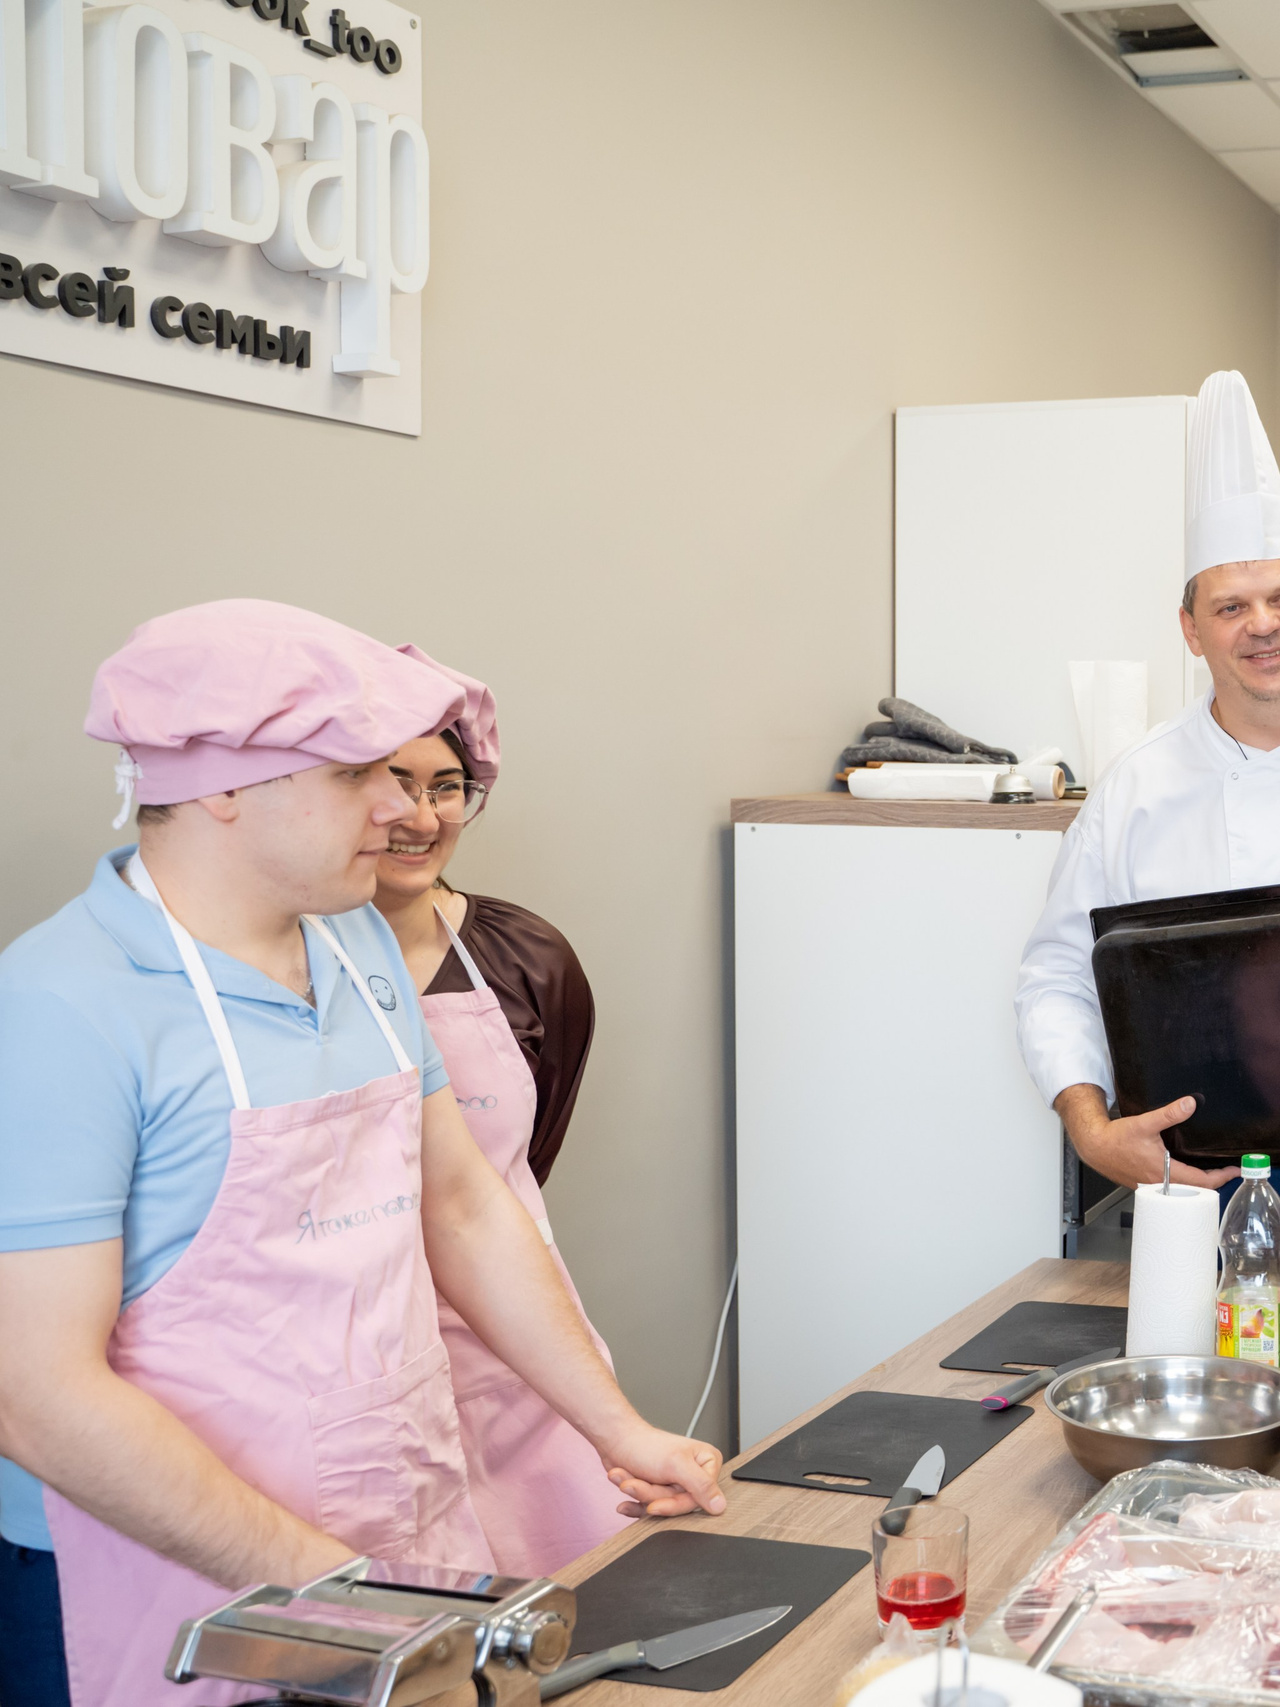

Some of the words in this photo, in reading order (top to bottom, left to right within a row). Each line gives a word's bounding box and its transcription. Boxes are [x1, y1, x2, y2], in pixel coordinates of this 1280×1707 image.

[222, 0, 402, 75] ok_too
[0, 253, 135, 328] всей
[150, 295, 311, 369] семьи
[296, 1208, 317, 1244] Я
